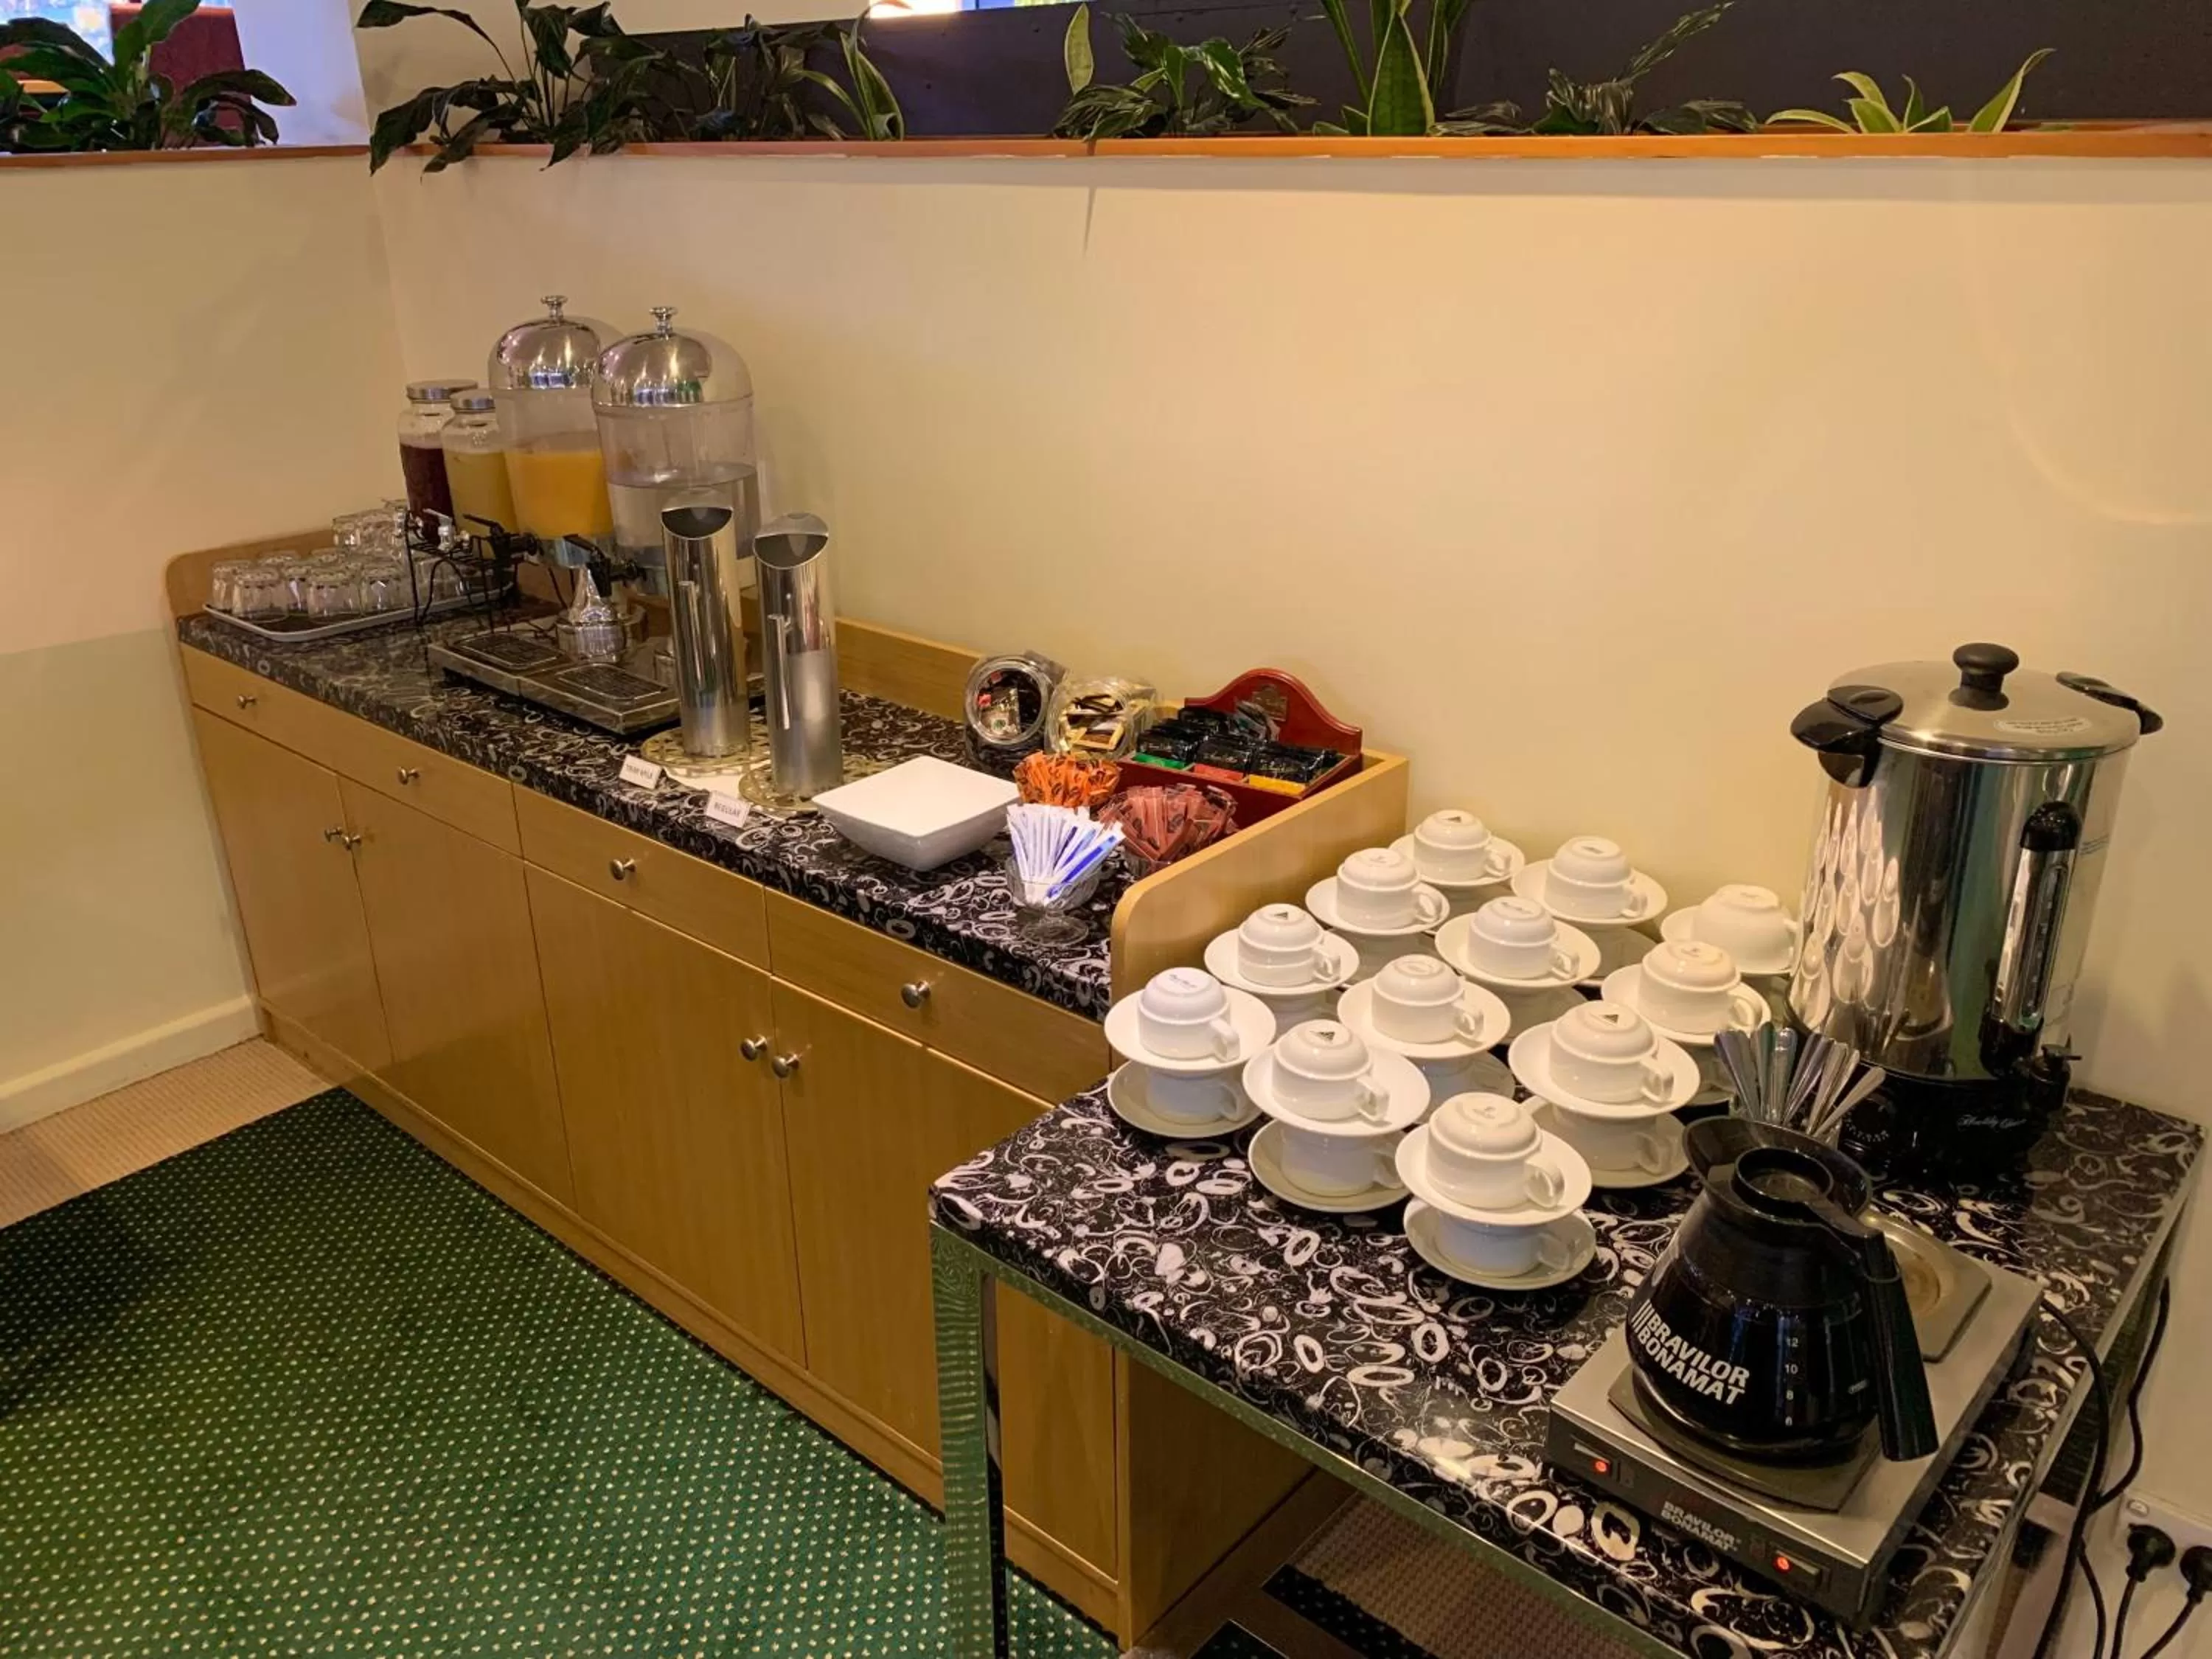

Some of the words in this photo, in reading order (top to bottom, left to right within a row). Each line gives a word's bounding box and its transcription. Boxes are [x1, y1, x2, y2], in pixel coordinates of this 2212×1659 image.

[1637, 1325, 1746, 1405] BONAMAT
[1646, 1312, 1750, 1388] BRAVILOR
[1785, 1337, 1799, 1348] 12
[1784, 1363, 1799, 1375] 10
[1660, 1509, 1730, 1551] BONAMAT
[1663, 1500, 1735, 1548] BRAVILOR
